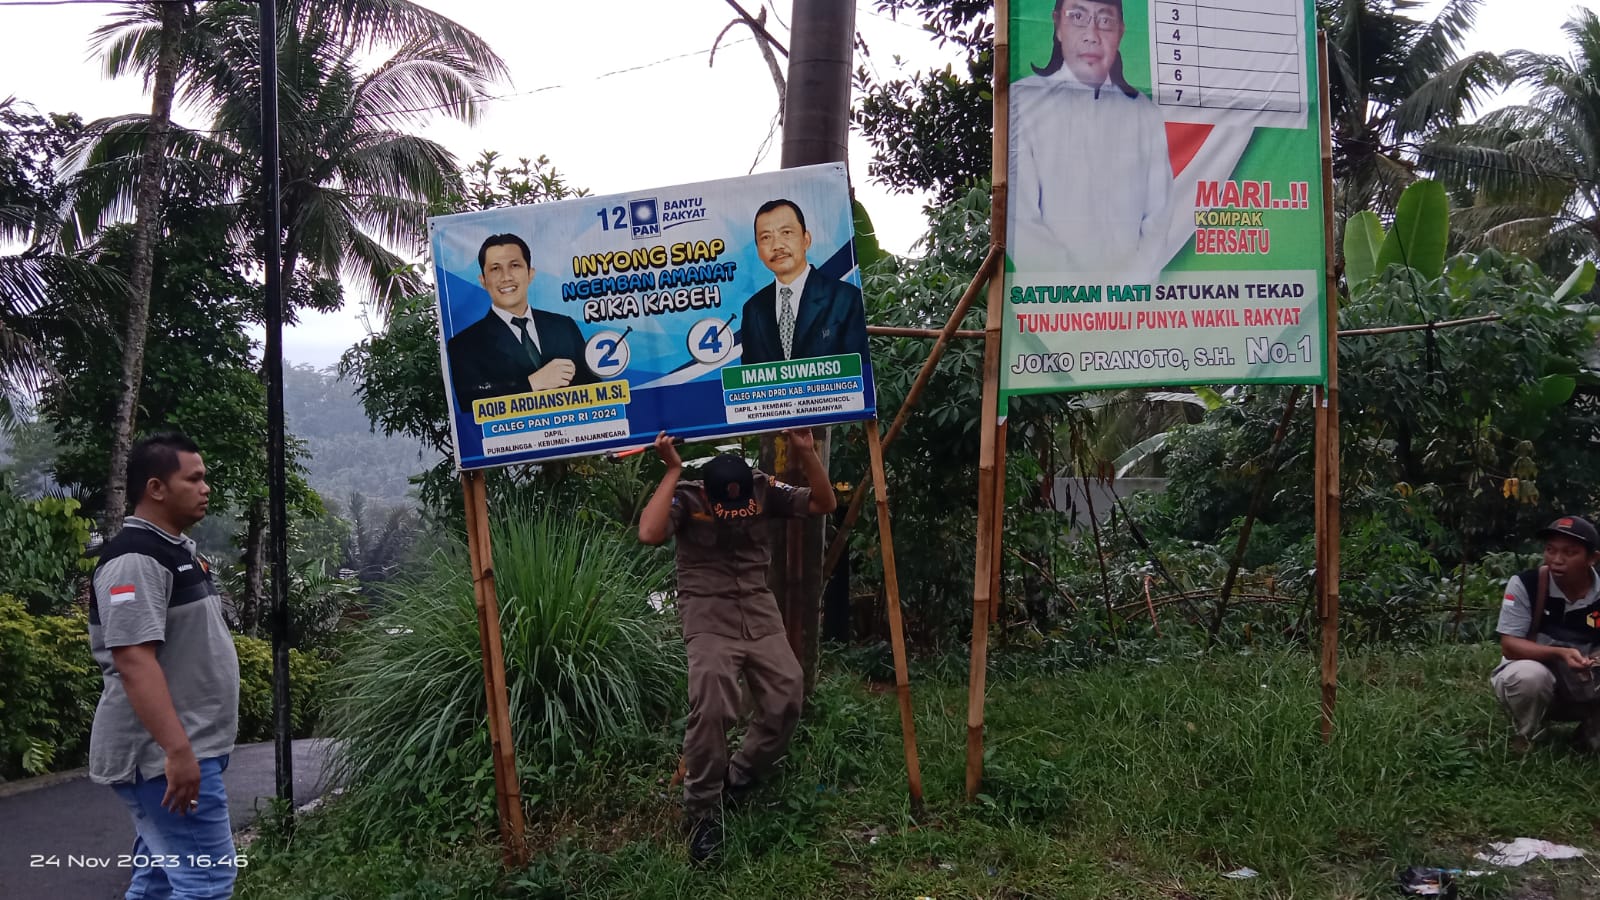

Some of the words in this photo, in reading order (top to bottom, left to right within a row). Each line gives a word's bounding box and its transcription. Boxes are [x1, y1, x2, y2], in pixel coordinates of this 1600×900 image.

[1172, 8, 1180, 21] 3
[1172, 29, 1181, 41] 4
[1173, 49, 1182, 61] 5
[1174, 69, 1183, 81] 6
[1175, 89, 1183, 101] 7
[663, 197, 703, 211] BANTU
[1194, 179, 1309, 210] MARI..!!
[597, 206, 628, 231] 12
[662, 208, 707, 222] RAKYAT
[1194, 211, 1263, 227] KOMPAK
[632, 224, 660, 236] PAN
[1195, 228, 1270, 255] BERSATU
[573, 245, 668, 277] INYONG
[671, 239, 725, 266] SIAP
[562, 272, 655, 301] NGEMBAN
[658, 262, 737, 289] AMANAT
[1010, 285, 1102, 304] SATUKAN
[1106, 284, 1152, 303] HATI
[1155, 284, 1239, 301] SATUKAN
[1244, 283, 1304, 299] TEKAD
[583, 295, 640, 323] RIKA
[644, 285, 721, 315] KABEH
[1017, 311, 1132, 333] TUNJUNGMULI
[1137, 310, 1188, 330] PUNYA
[1191, 309, 1240, 328] WAKIL
[1244, 307, 1302, 327] RAKYAT
[698, 325, 723, 354] 4
[595, 338, 620, 368] 2
[1011, 352, 1074, 374] JOKO
[1080, 348, 1189, 371] PRANOTO,
[1194, 346, 1235, 366] S.H.
[741, 367, 778, 385] IMAM
[780, 360, 841, 380] SUWARSO
[478, 400, 507, 418] AQIB
[510, 390, 593, 414] ARDIANSYAH,
[595, 384, 627, 402] M.Si.
[729, 392, 751, 402] CALEG
[752, 390, 767, 399] PAN
[768, 388, 787, 398] DPRD
[789, 386, 805, 395] KAB.
[807, 381, 859, 393] PURBALINGGA
[762, 402, 792, 411] REMBANG
[491, 419, 525, 434] CALEG
[528, 417, 550, 429] PAN
[554, 413, 575, 425] DPR
[578, 411, 588, 422] RI
[592, 408, 618, 420] 2024
[544, 429, 564, 438] DAPIL
[487, 443, 533, 455] PURBALINGGA
[538, 438, 570, 448] KEBUMEN
[575, 430, 627, 443] BANJARNEGARA
